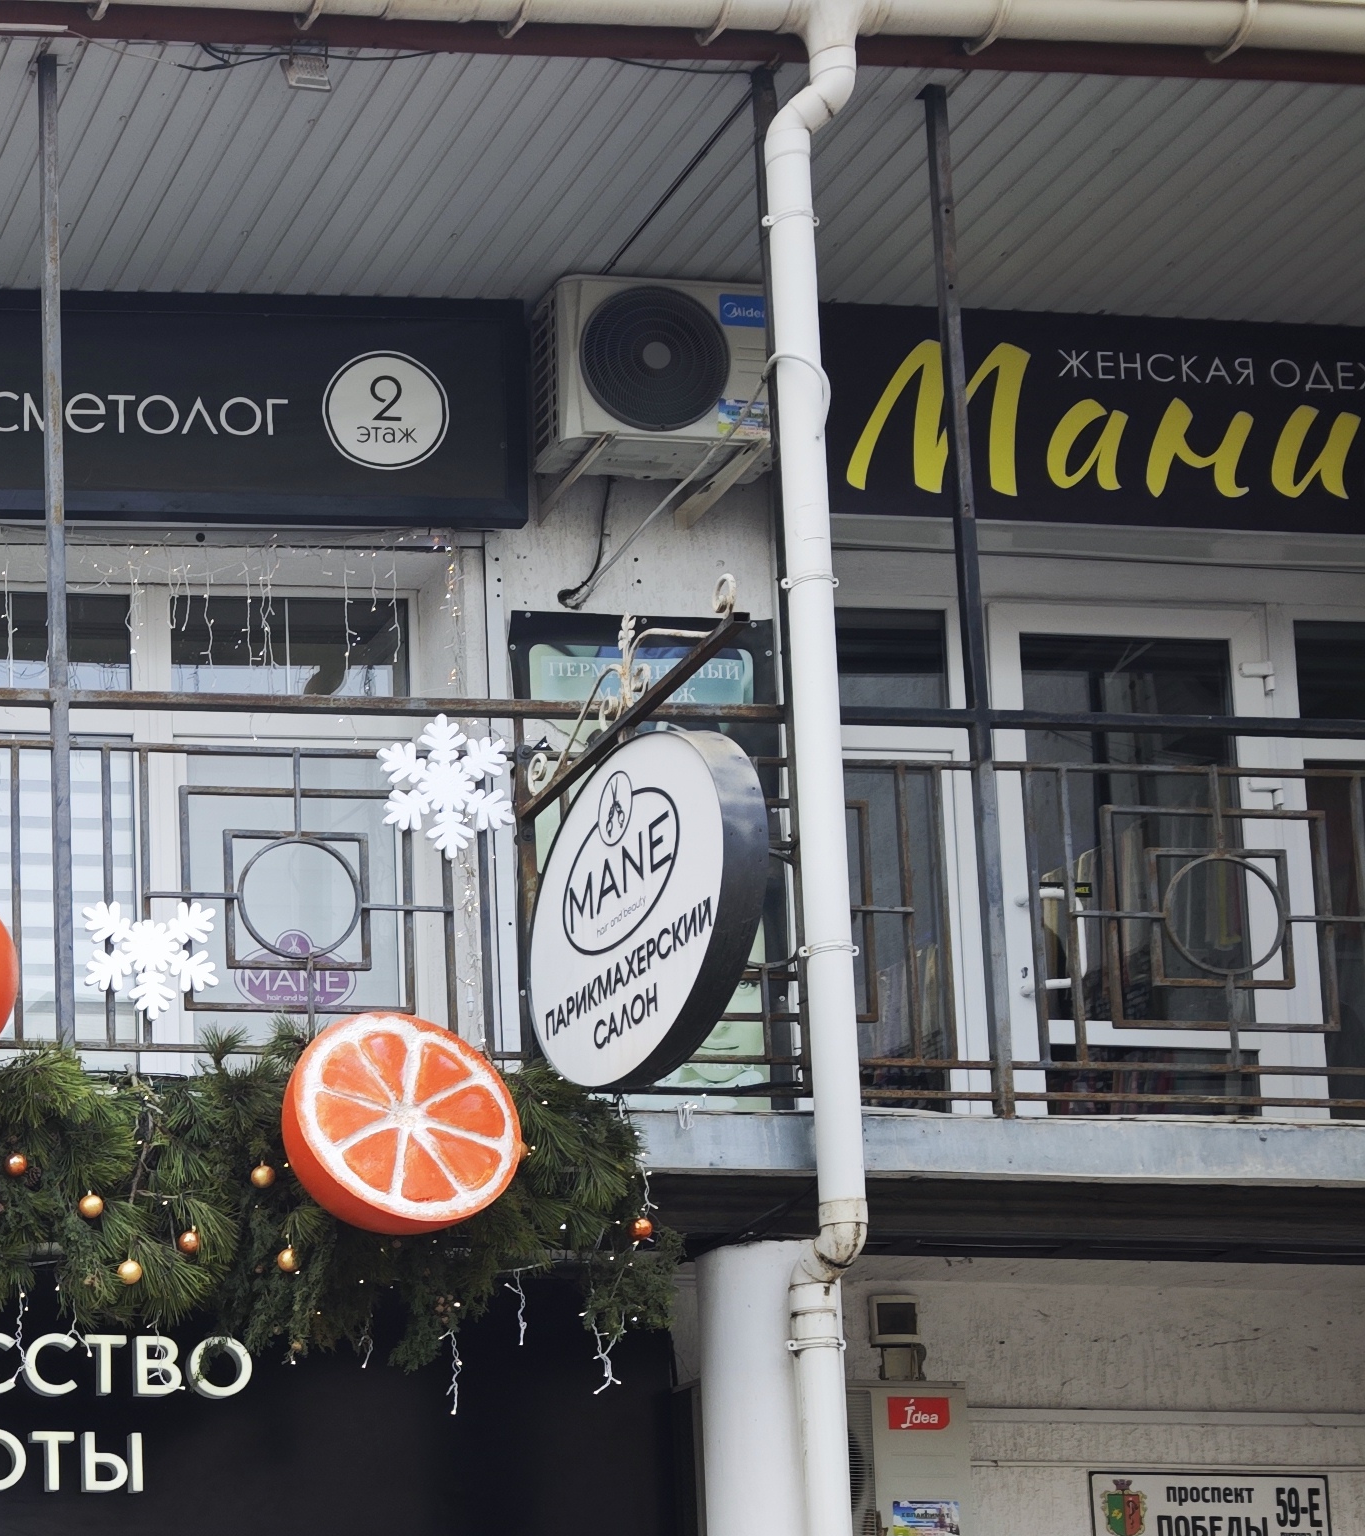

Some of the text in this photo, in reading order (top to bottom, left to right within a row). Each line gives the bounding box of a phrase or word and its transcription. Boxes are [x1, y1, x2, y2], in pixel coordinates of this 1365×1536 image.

[1058, 349, 1255, 386] ЖЕНСКАЯ
[371, 375, 402, 422] 2
[355, 426, 418, 445] этаж
[570, 810, 672, 934] MANE
[545, 896, 713, 1041] ПАРИКМАХЕРСКИЙ
[594, 982, 658, 1050] САЛОН
[1165, 1486, 1254, 1506] проспект
